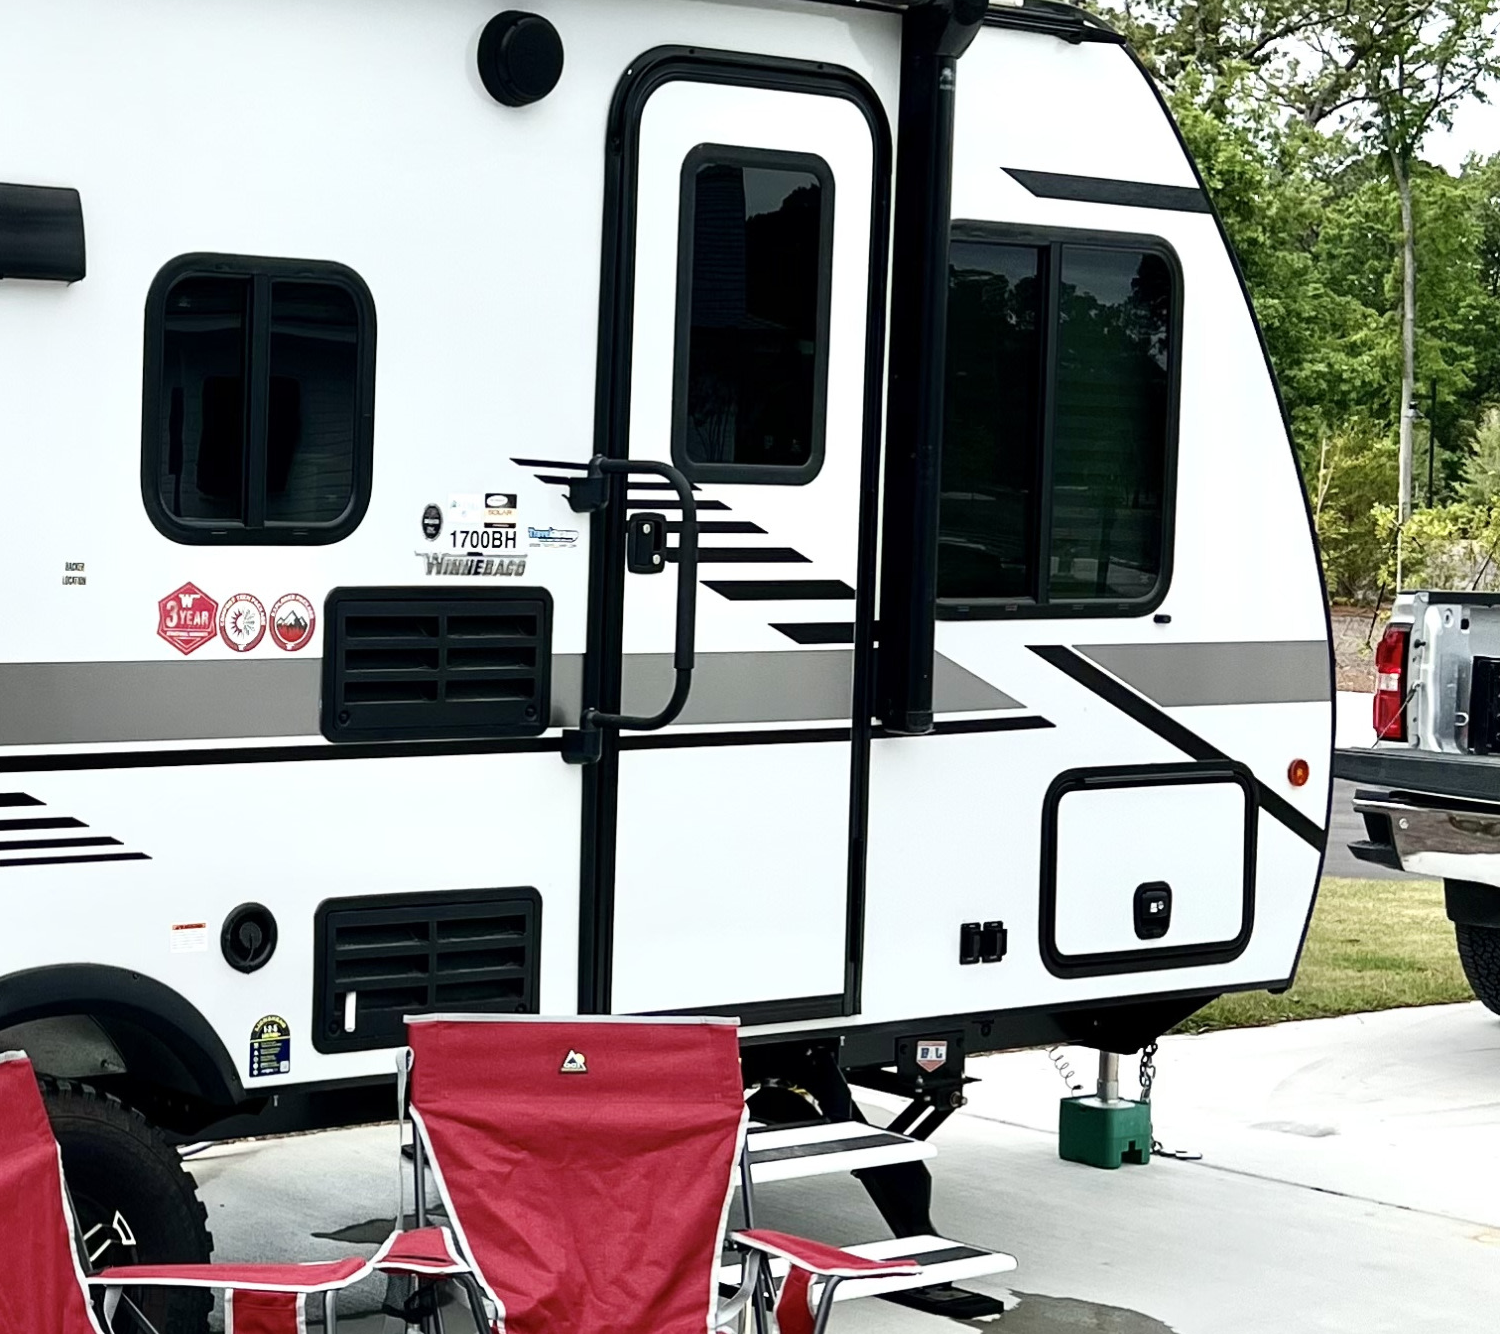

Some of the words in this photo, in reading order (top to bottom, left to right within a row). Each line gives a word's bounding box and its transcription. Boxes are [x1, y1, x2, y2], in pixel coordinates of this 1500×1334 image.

[450, 530, 517, 549] 1700BH
[420, 552, 527, 577] WINNEBAGO
[166, 600, 179, 628] 3
[180, 610, 209, 627] YEAR
